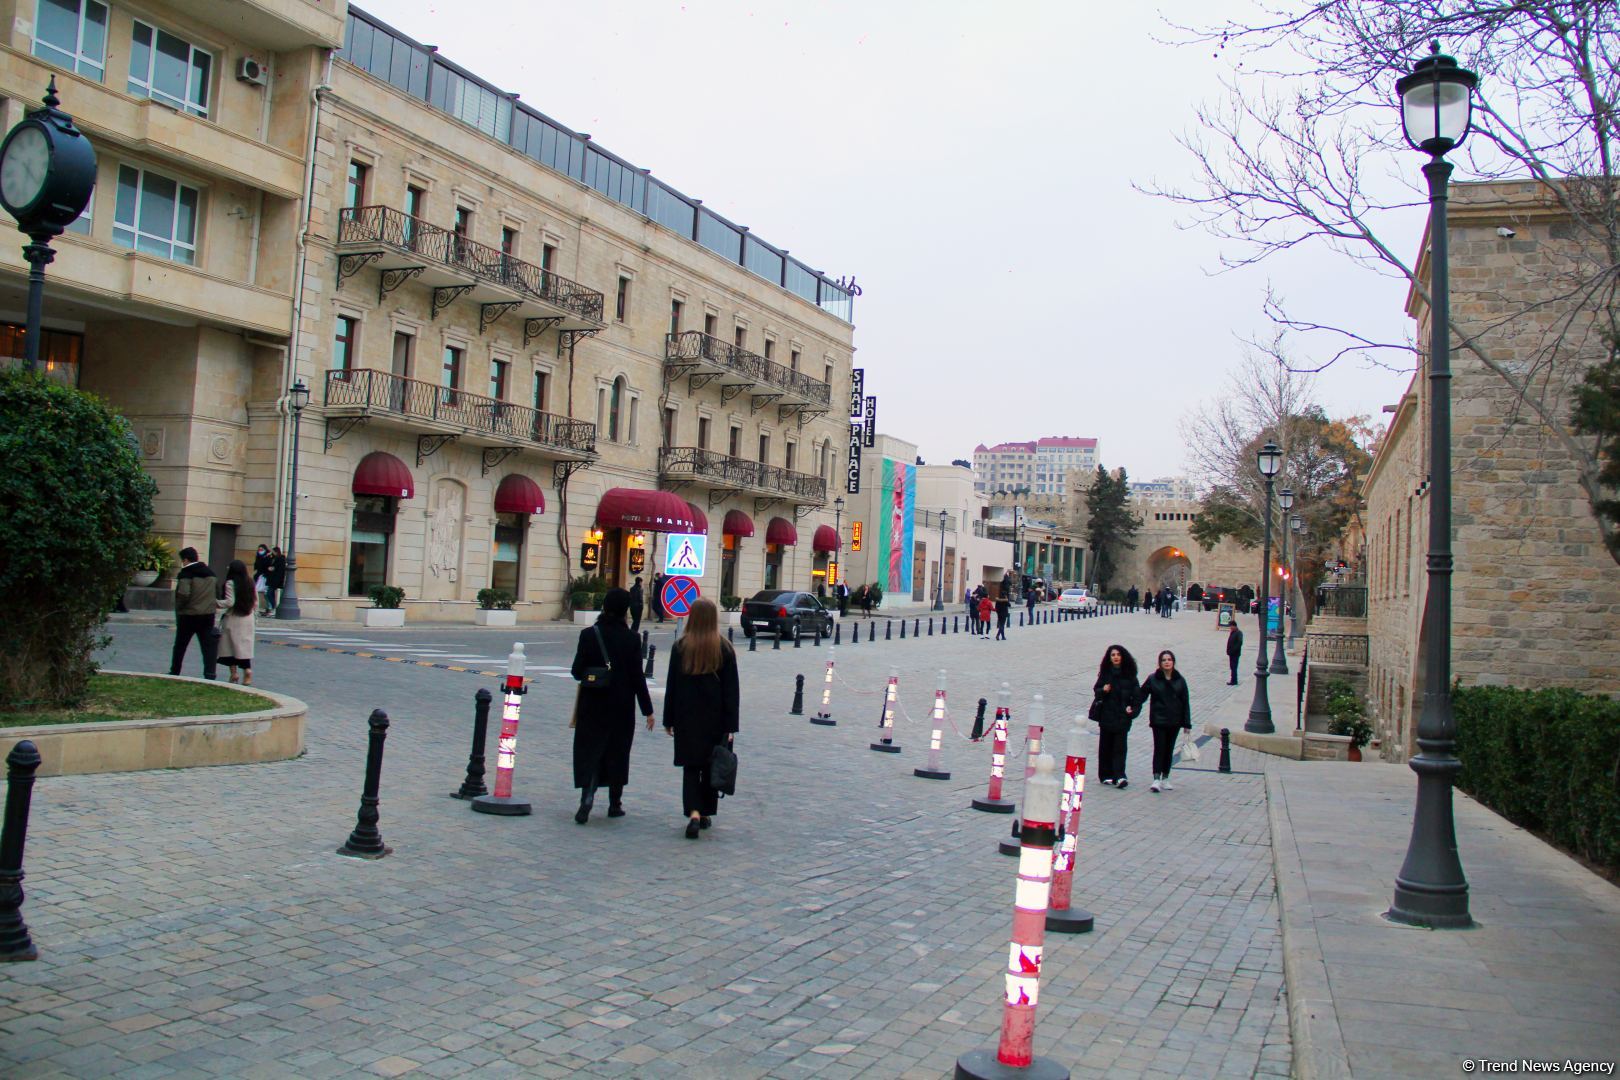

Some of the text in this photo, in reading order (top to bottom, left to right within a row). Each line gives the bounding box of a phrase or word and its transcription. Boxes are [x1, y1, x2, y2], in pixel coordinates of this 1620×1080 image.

[848, 370, 861, 492] SHAH PALACE
[865, 398, 875, 446] HOTEL
